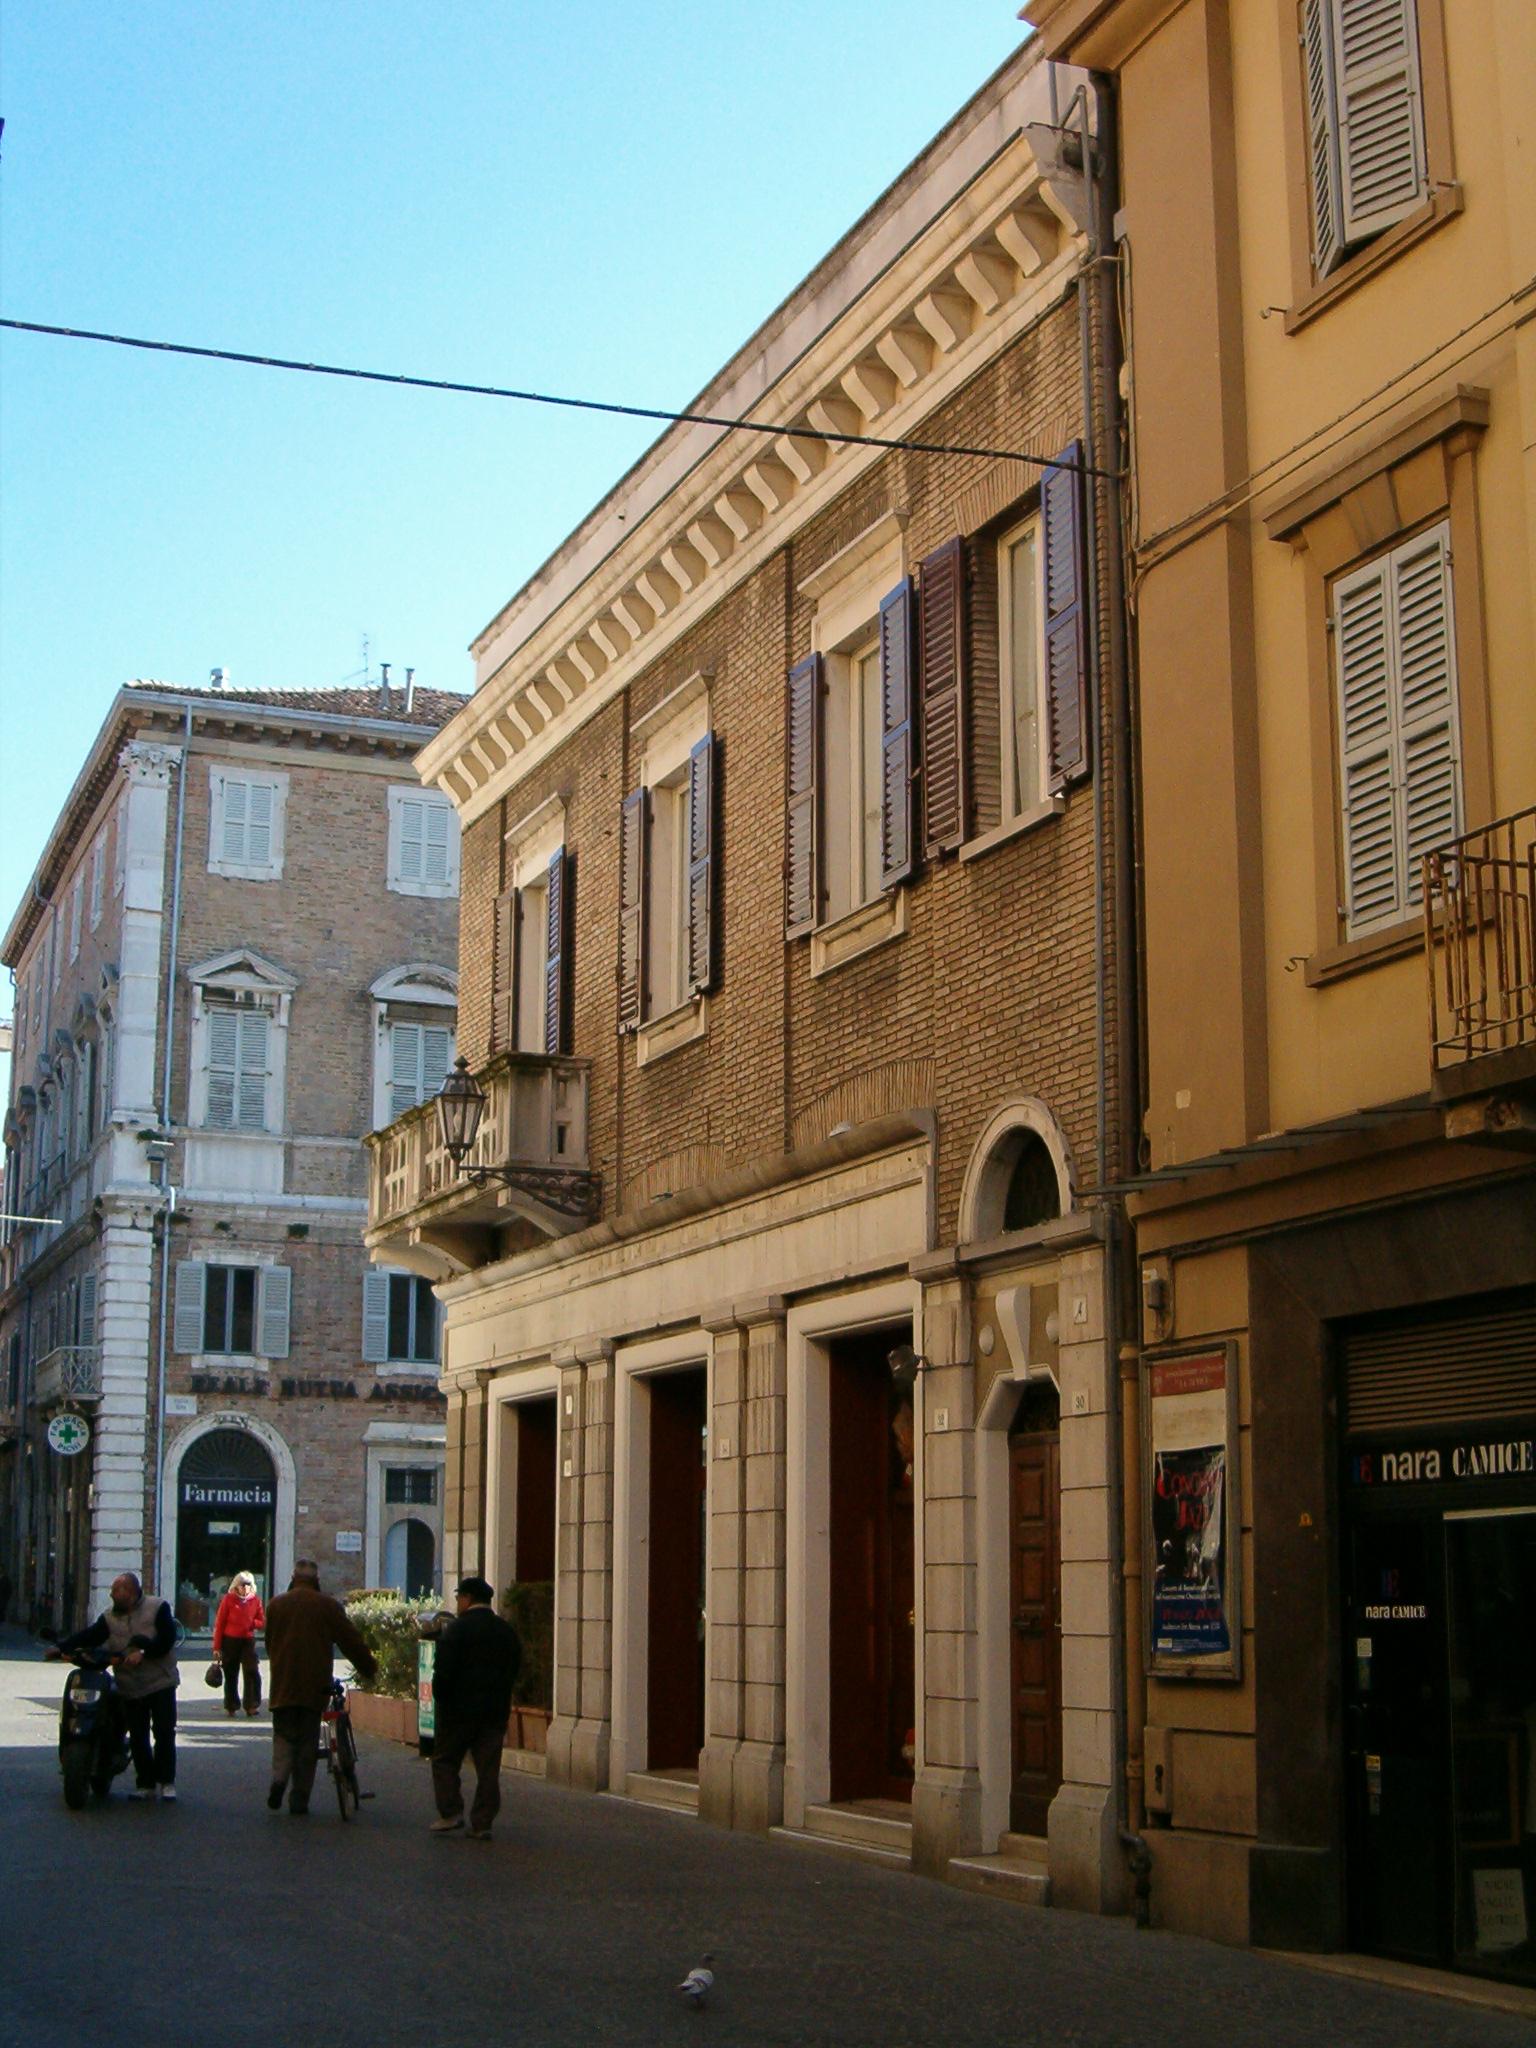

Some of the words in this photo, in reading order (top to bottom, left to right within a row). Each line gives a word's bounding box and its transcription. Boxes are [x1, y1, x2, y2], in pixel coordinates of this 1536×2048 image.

[190, 1374, 270, 1397] REALE
[281, 1378, 358, 1399] MUTUA
[49, 1415, 87, 1437] FARMACIA
[1382, 1448, 1441, 1481] nara
[1452, 1440, 1533, 1477] CAMICE
[184, 1483, 272, 1503] Farmacia
[1365, 1605, 1391, 1619] nara
[1391, 1605, 1426, 1619] CAMICE
